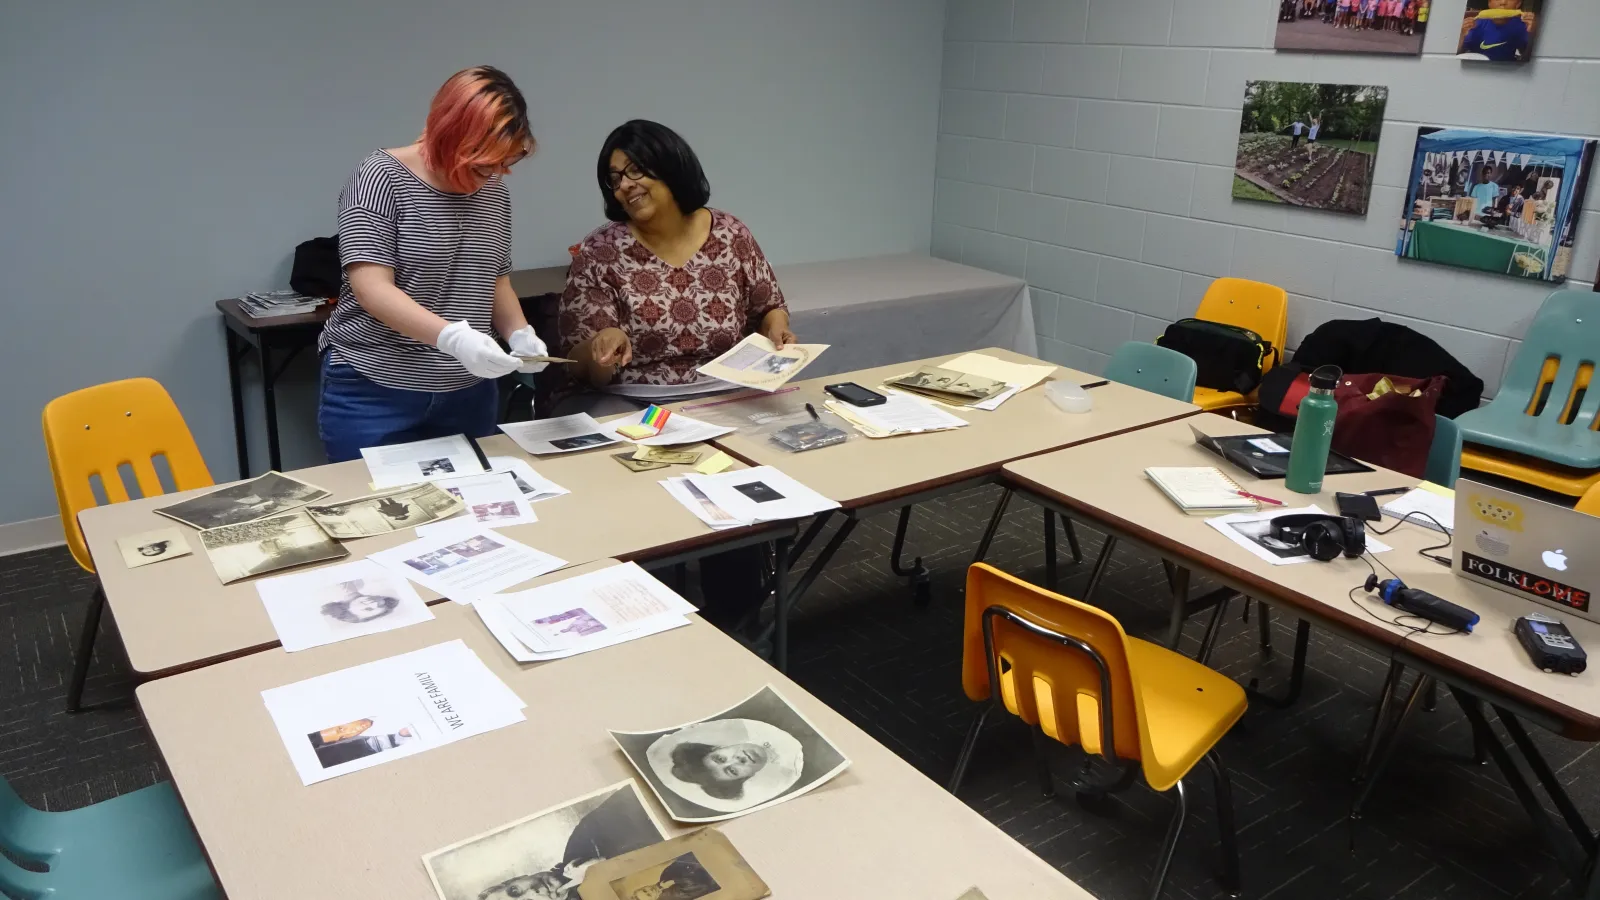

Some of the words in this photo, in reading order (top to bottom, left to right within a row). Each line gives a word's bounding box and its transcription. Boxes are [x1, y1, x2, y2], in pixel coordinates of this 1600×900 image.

[414, 672, 444, 698] FAMILY
[433, 697, 455, 713] ARE
[444, 713, 464, 731] WE
